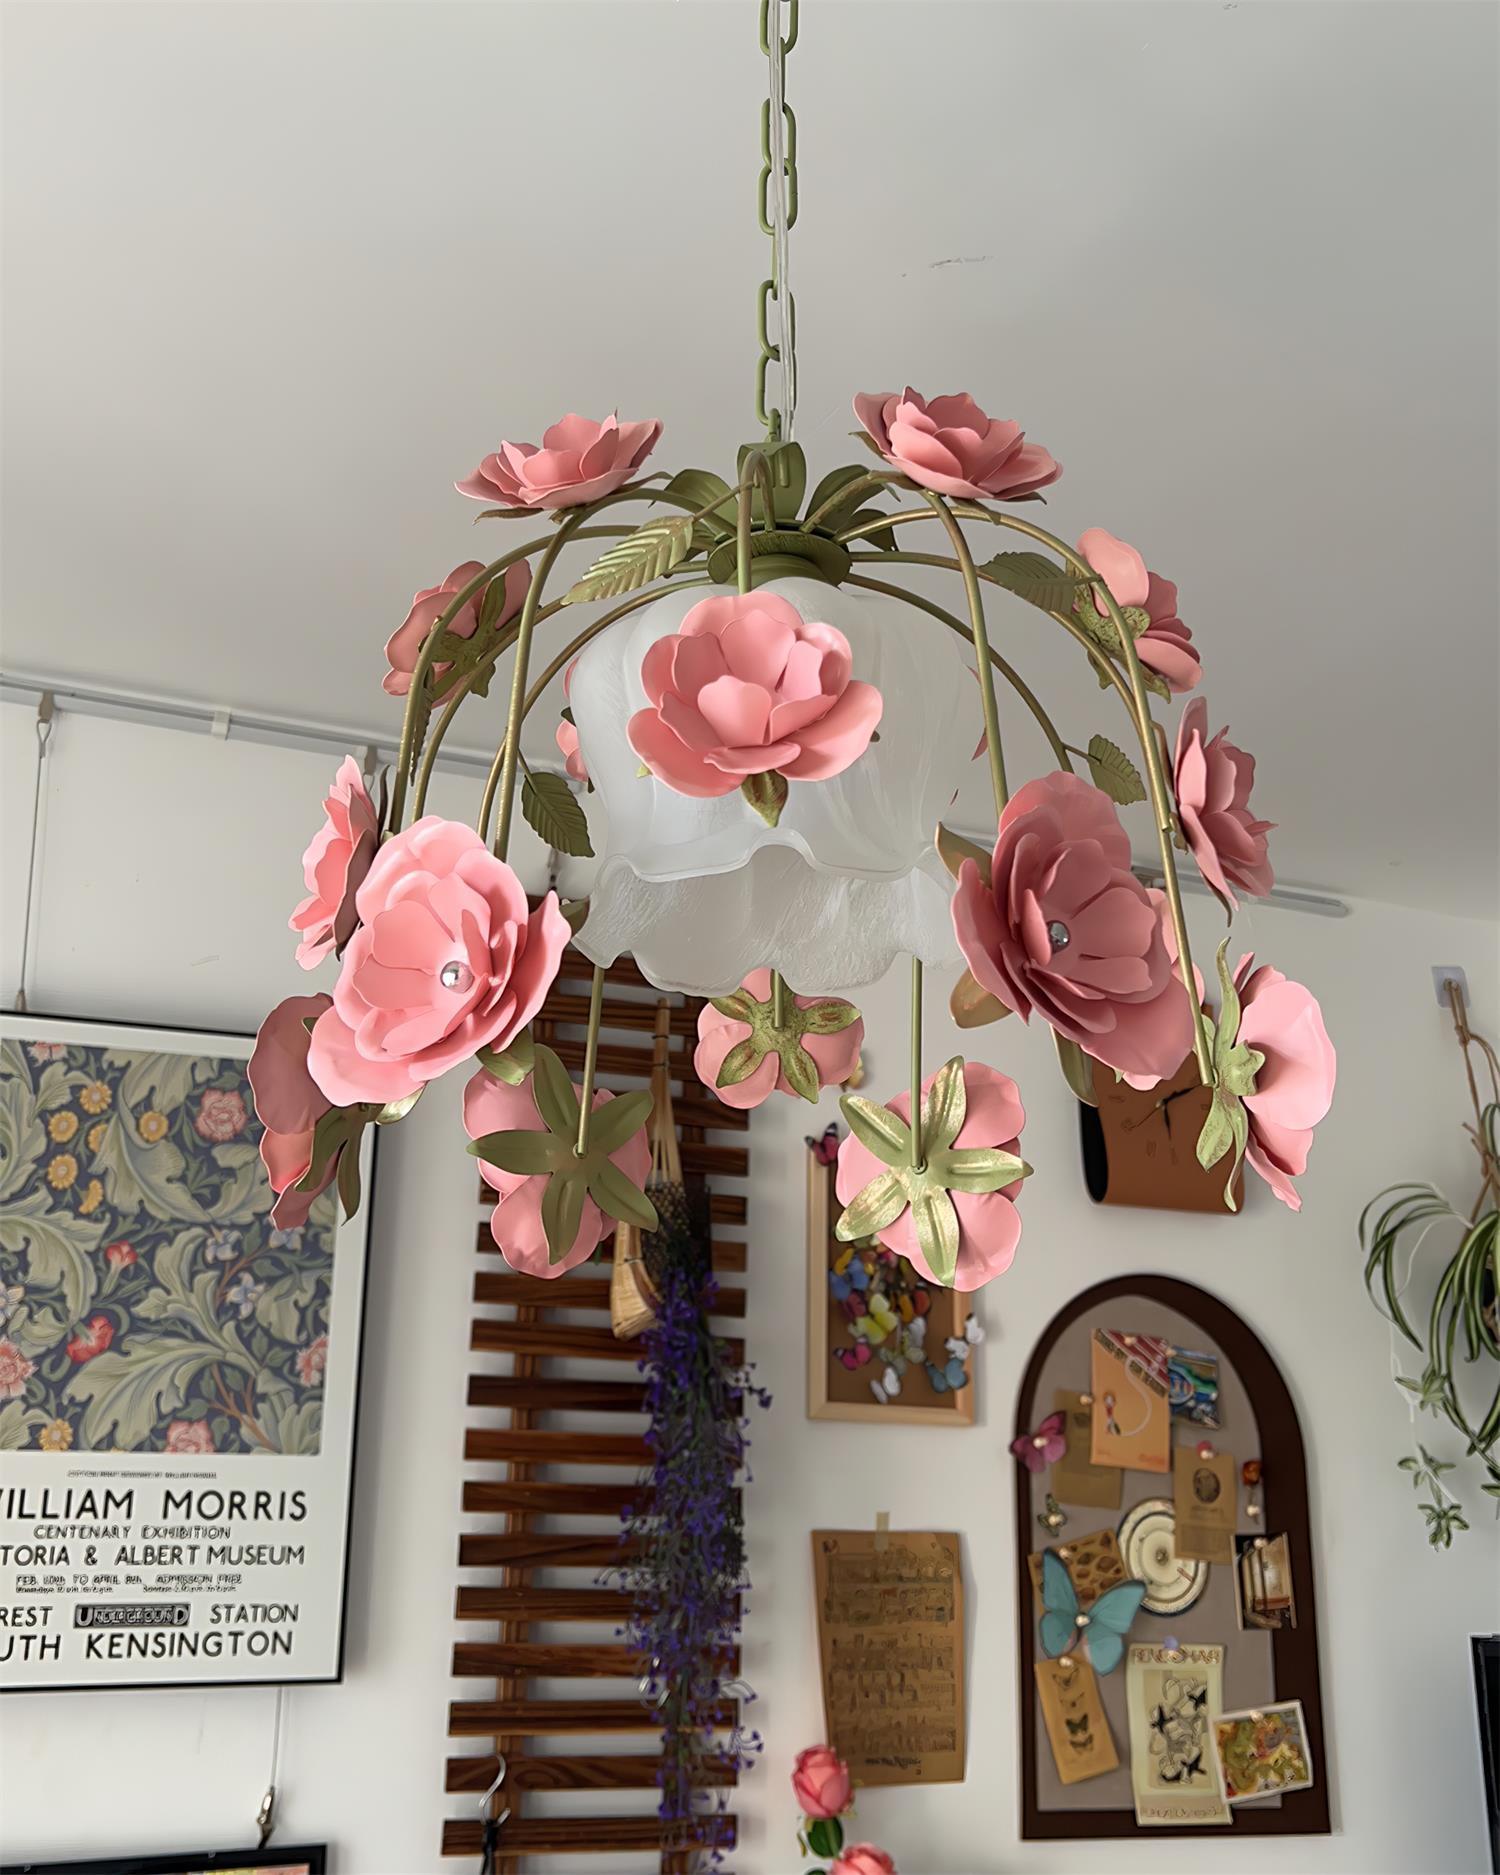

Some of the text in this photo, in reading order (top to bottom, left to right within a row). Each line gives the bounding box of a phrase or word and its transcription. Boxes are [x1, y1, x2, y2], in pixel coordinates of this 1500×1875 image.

[0, 1487, 307, 1521] ILLIAM MORRIS
[33, 1524, 232, 1540] CENTENARY EXHIBITION
[0, 1544, 305, 1567] TORIA & ALBERT MUSEUM
[209, 1603, 299, 1624] STATION
[86, 1631, 293, 1660] KENSINGTON
